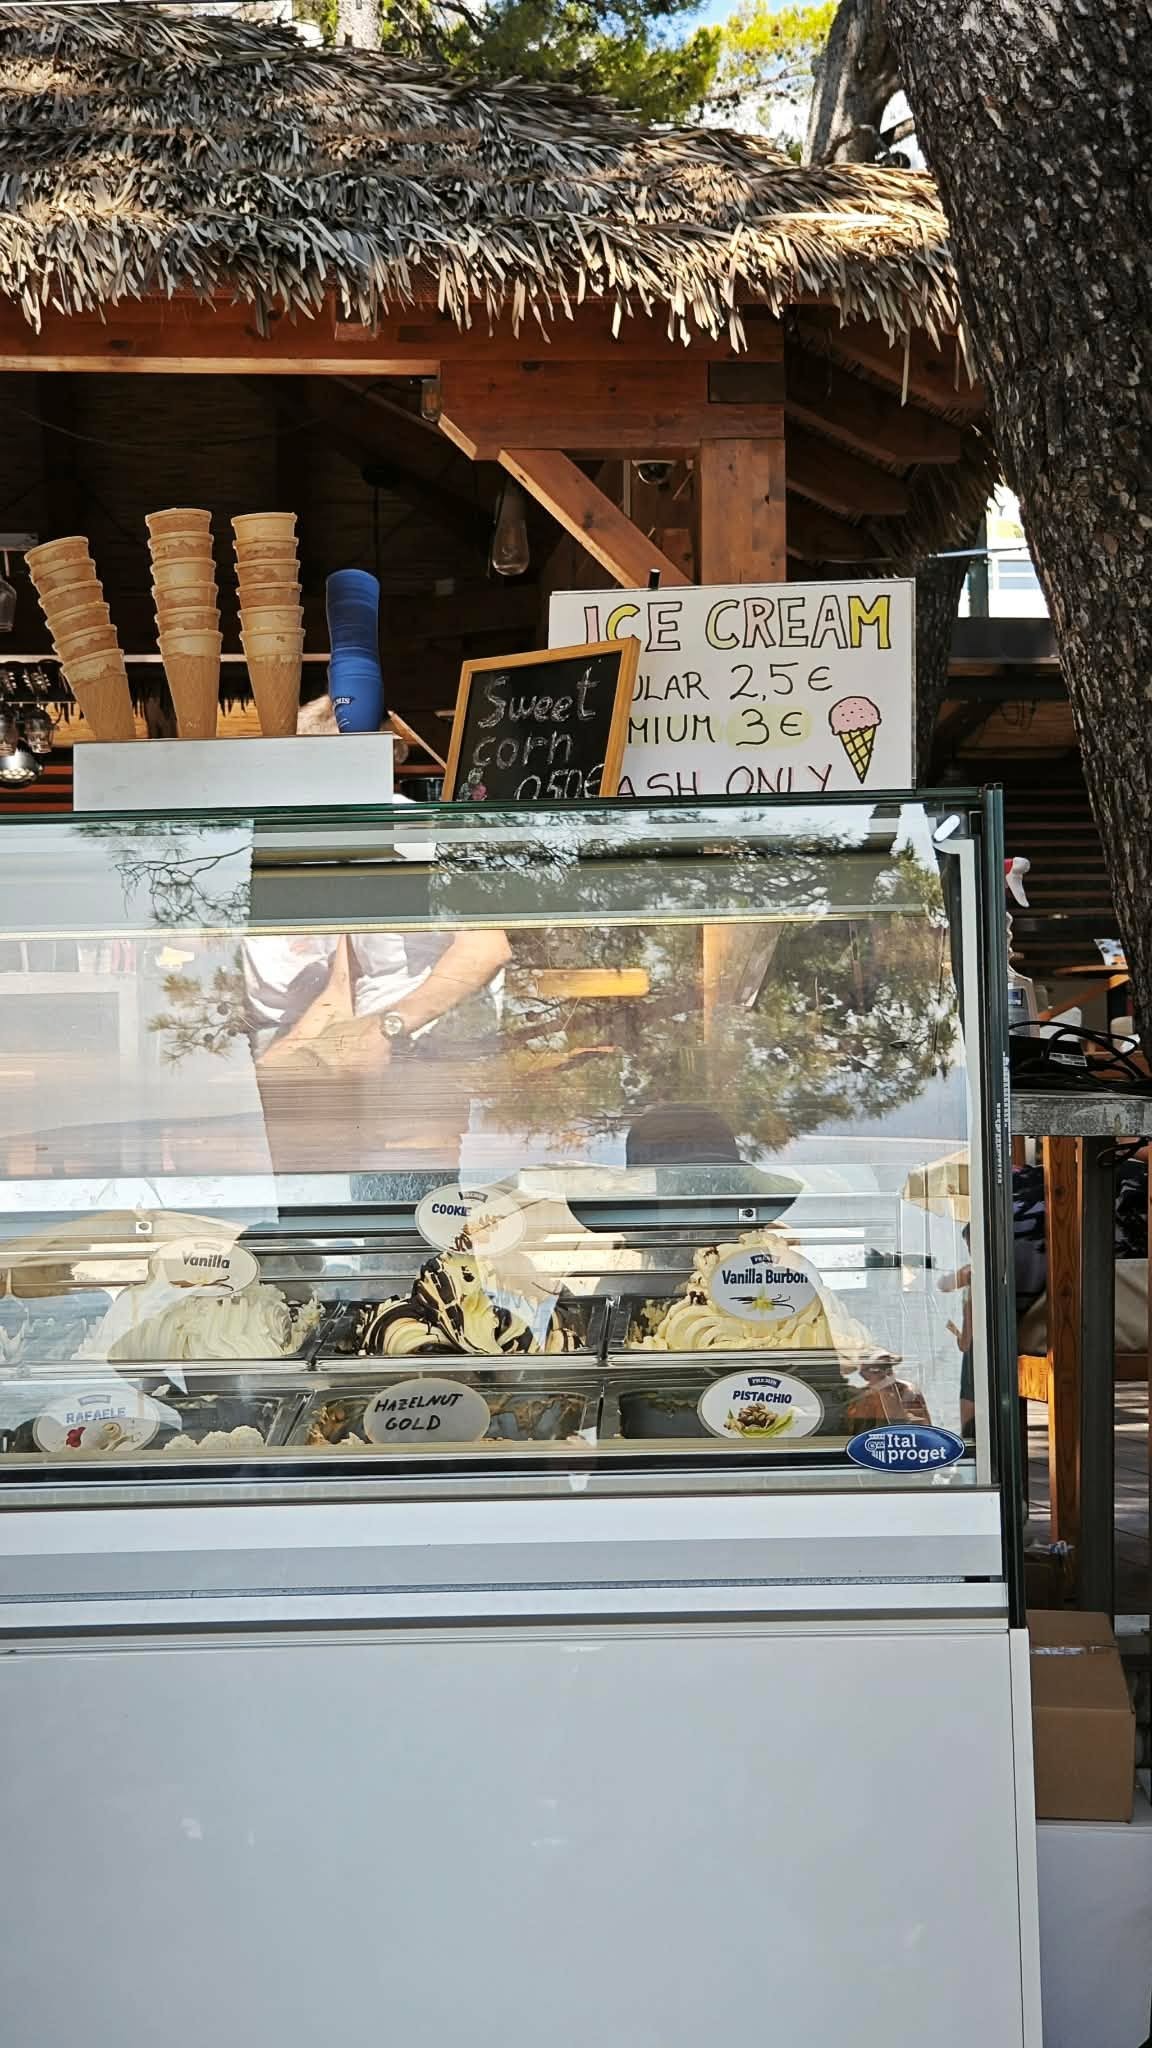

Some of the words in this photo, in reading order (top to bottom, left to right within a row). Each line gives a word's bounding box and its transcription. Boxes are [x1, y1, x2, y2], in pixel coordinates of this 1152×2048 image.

[584, 600, 682, 652] ICE
[705, 594, 891, 650] CREAM
[478, 667, 600, 728] Sweet
[472, 730, 573, 769] corn
[182, 1250, 231, 1269] Vanilla
[721, 1267, 762, 1285] Vanilla
[765, 1267, 809, 1284] Burbon
[374, 1393, 463, 1412] HAZELNUT
[732, 1390, 793, 1404] PISTACHIO
[385, 1414, 441, 1431] GOLD
[887, 1433, 918, 1448] Ital
[887, 1446, 947, 1464] proget
